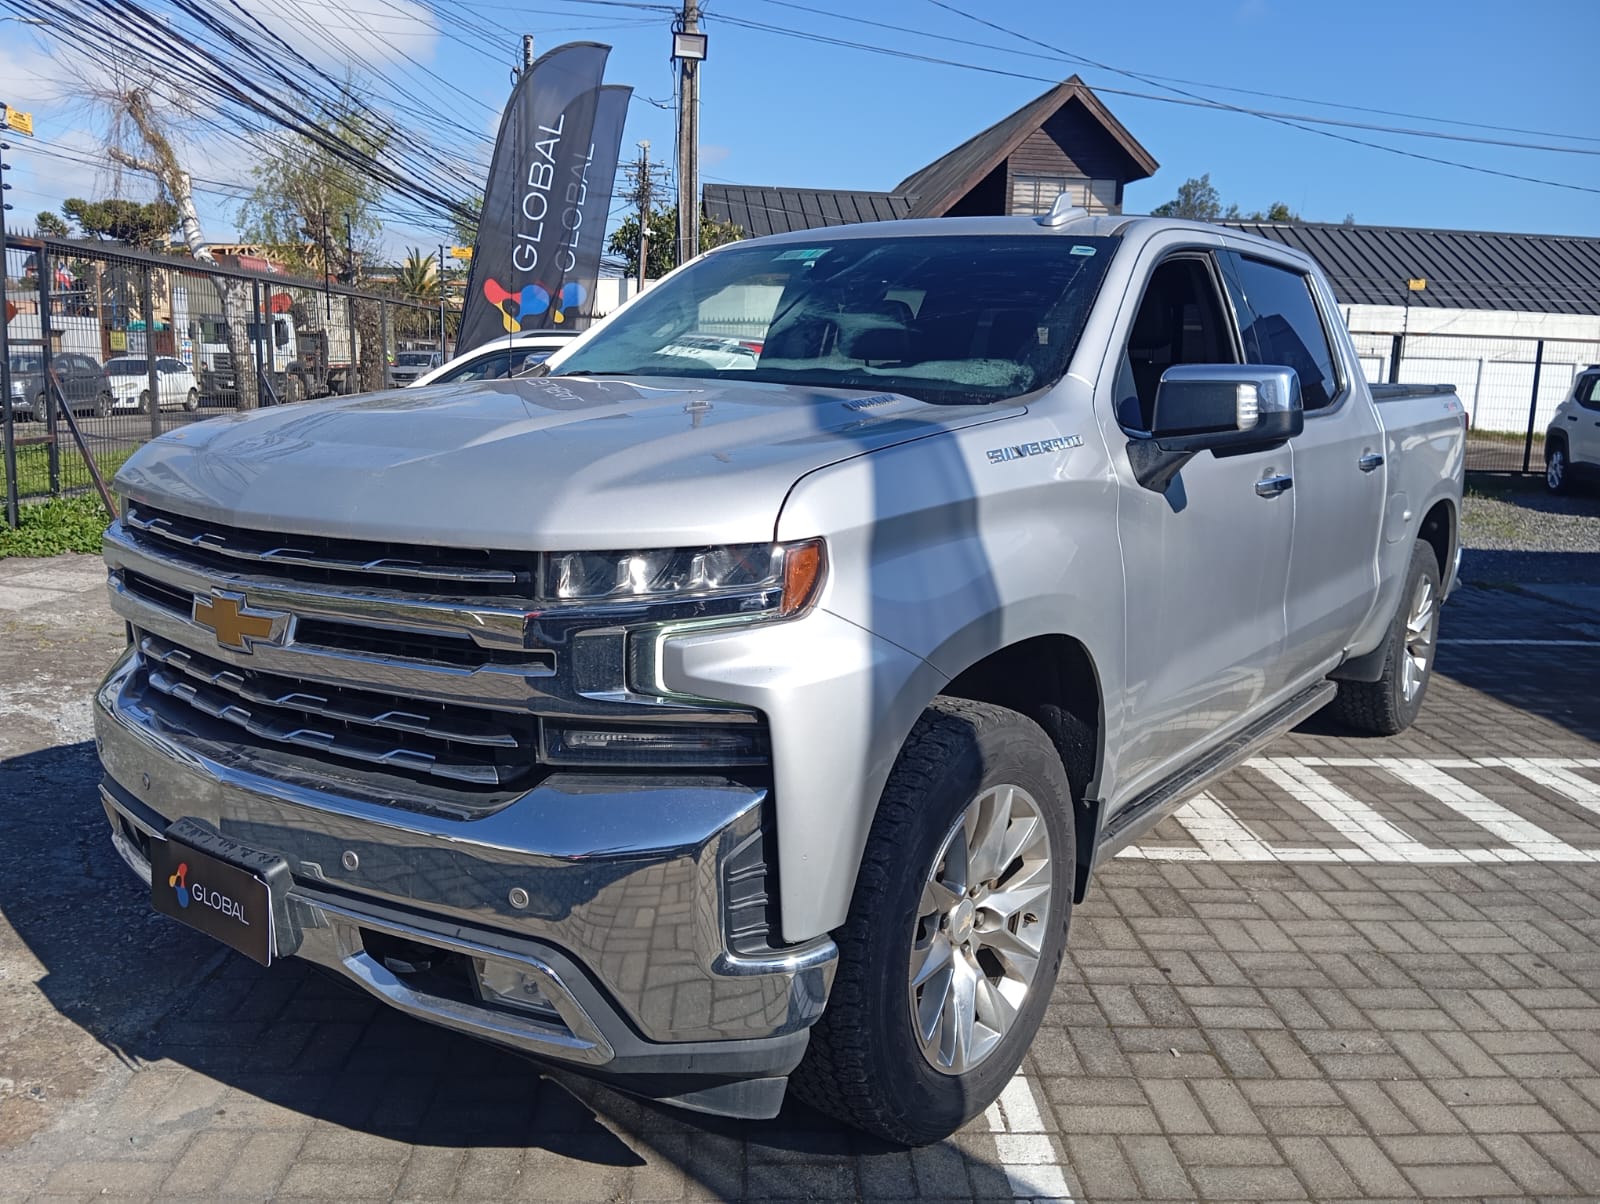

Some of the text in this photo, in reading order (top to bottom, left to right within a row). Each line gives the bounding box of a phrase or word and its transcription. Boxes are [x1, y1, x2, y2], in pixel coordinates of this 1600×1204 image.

[513, 114, 564, 272] GLOBAL
[555, 143, 594, 273] GLOBAL
[191, 883, 250, 926] GLOBAL
